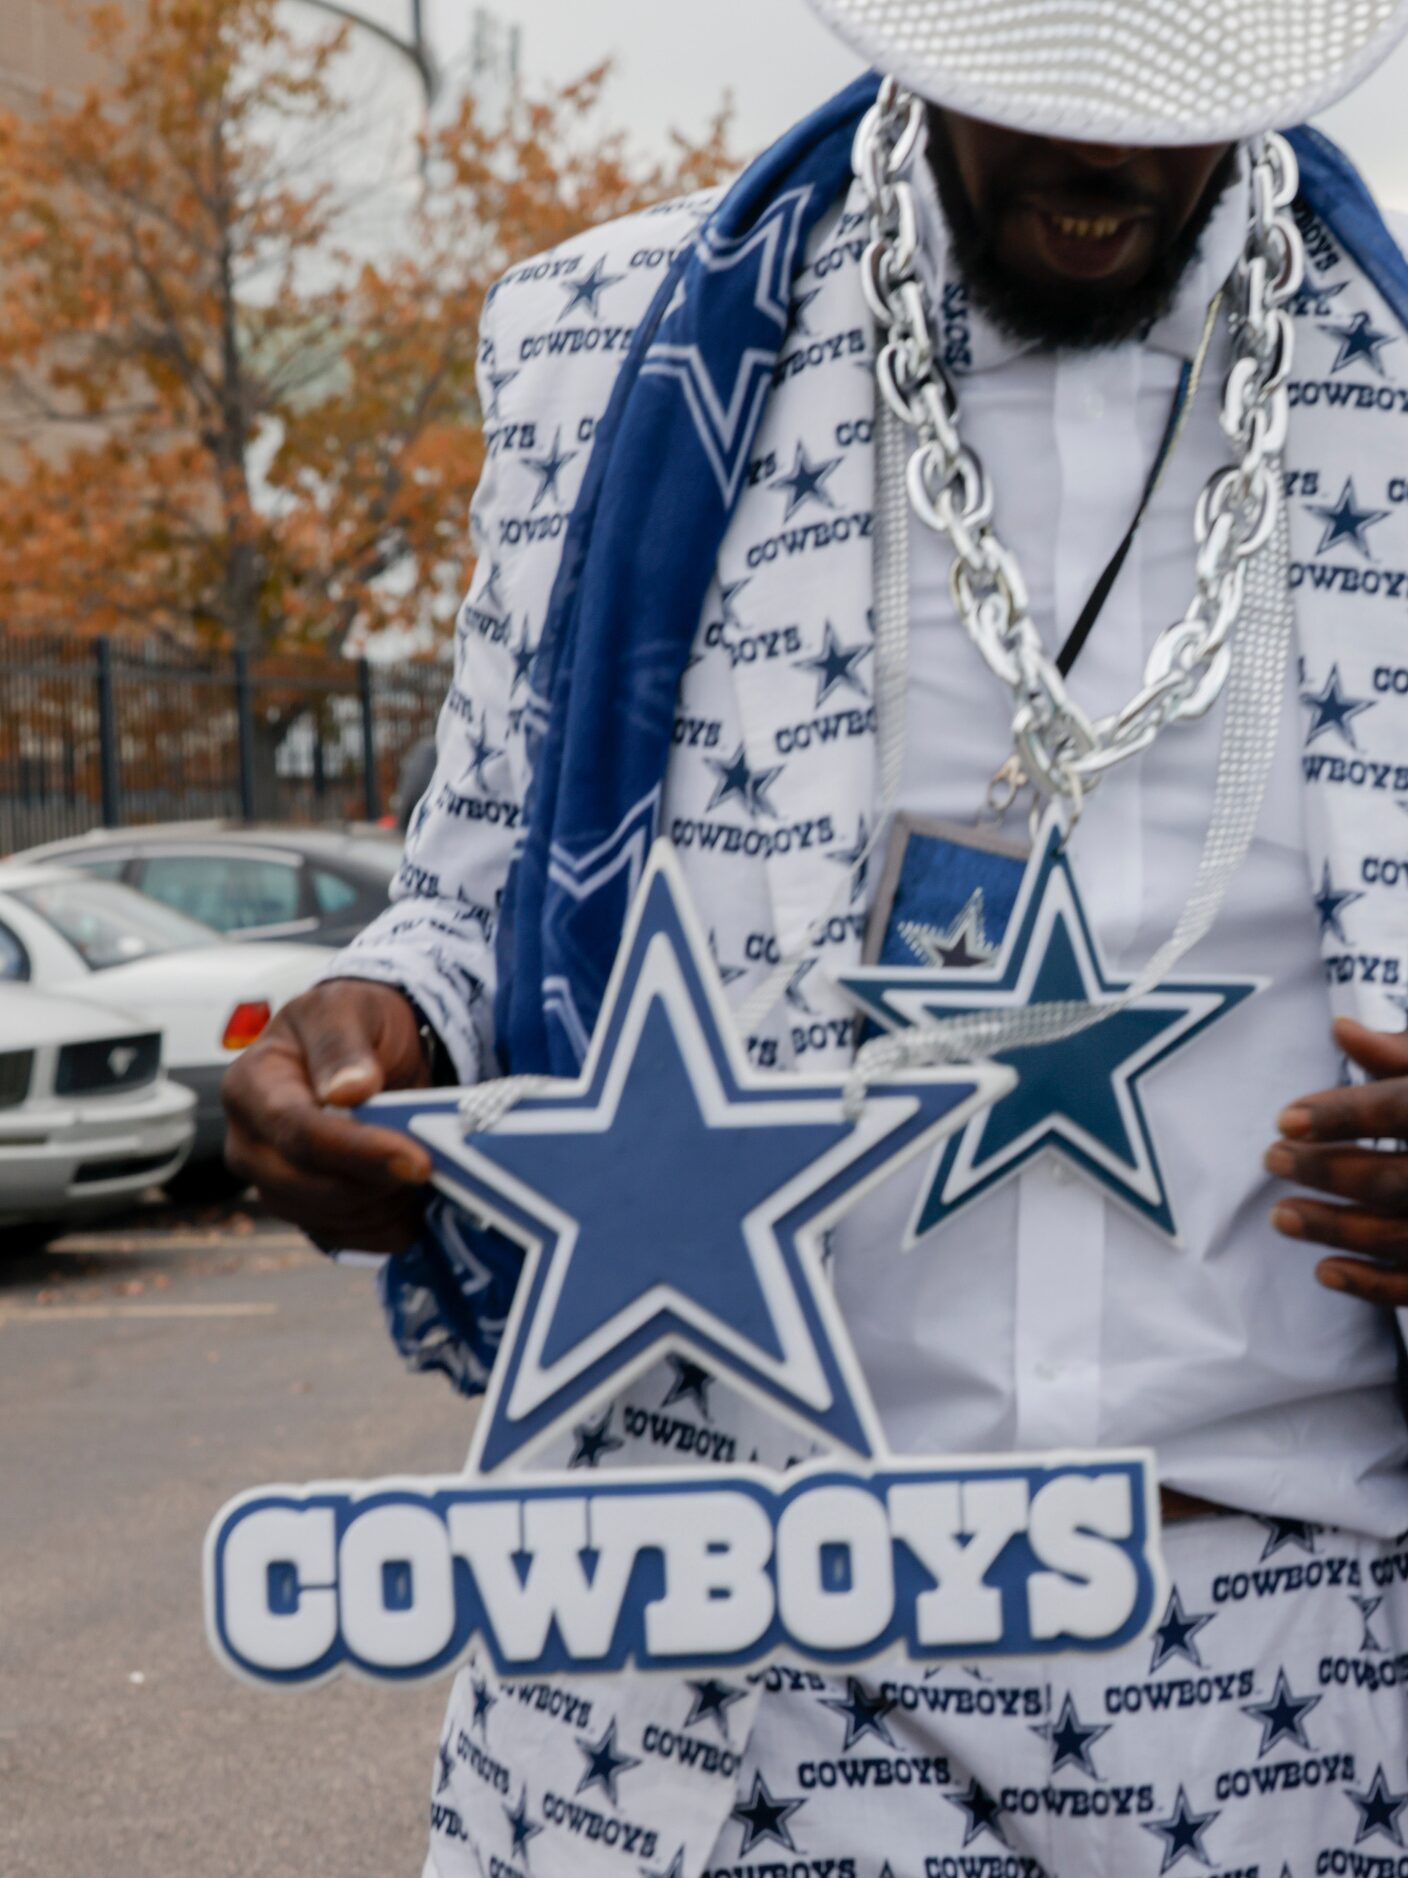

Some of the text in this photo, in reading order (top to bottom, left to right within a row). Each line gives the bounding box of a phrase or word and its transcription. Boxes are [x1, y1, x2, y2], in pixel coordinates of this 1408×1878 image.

[747, 511, 874, 568] COWBOY
[221, 1474, 1140, 1670] COWBOYS
[1212, 1556, 1361, 1604] COWBOYS
[879, 1681, 1042, 1717] COWBOYS
[1105, 1669, 1255, 1715] COWBOYS
[642, 1724, 742, 1778] COWBO
[798, 1757, 950, 1790] COWBOYS
[1001, 1785, 1154, 1817] COWBOYS
[1215, 1754, 1355, 1801] COWBOYS
[542, 1792, 661, 1860] COWBOYS
